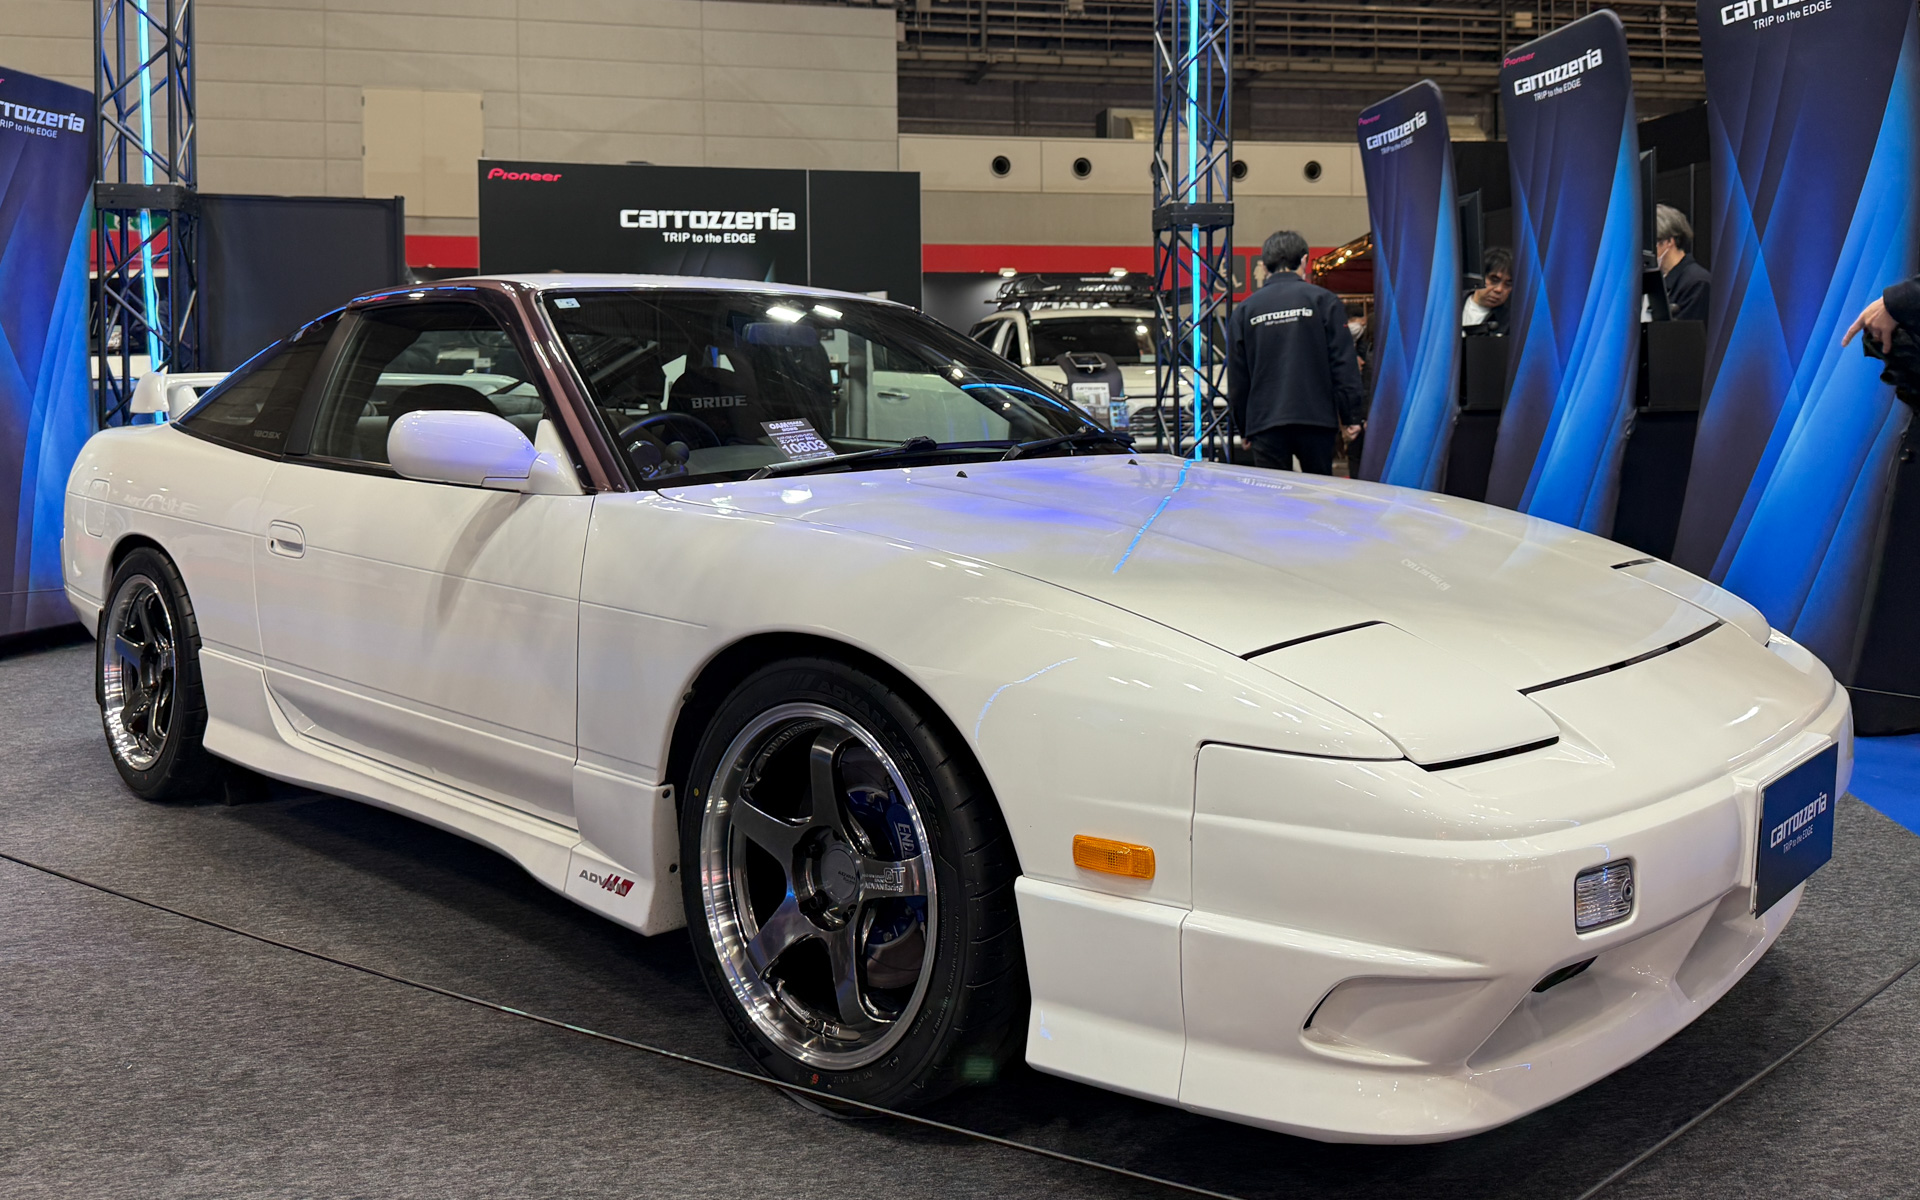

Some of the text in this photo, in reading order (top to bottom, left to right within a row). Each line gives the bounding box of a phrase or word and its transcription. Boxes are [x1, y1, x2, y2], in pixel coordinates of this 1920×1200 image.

[1753, 15, 1774, 30] TRIP
[1776, 14, 1785, 23] to
[1786, 10, 1801, 21] the
[1802, 0, 1832, 16] EDGE
[1503, 52, 1535, 69] Pioneer
[1514, 48, 1602, 96] carrozzeria
[1533, 89, 1547, 102] TRIP
[1563, 78, 1581, 92] EDGE
[15, 124, 23, 132] to
[23, 125, 35, 135] the
[36, 127, 58, 139] EDGE
[1366, 111, 1428, 150] carrozzeria
[487, 167, 562, 182] Pioneer
[620, 207, 796, 231] carrozzeria
[662, 232, 756, 244] TRIP to the EDGE
[1249, 307, 1313, 326] carrozzeria
[690, 395, 748, 409] BRIDE
[781, 439, 828, 454] 10803
[1770, 791, 1828, 849] carrozzeria
[579, 869, 628, 896] ADVAN
[884, 866, 906, 884] GT
